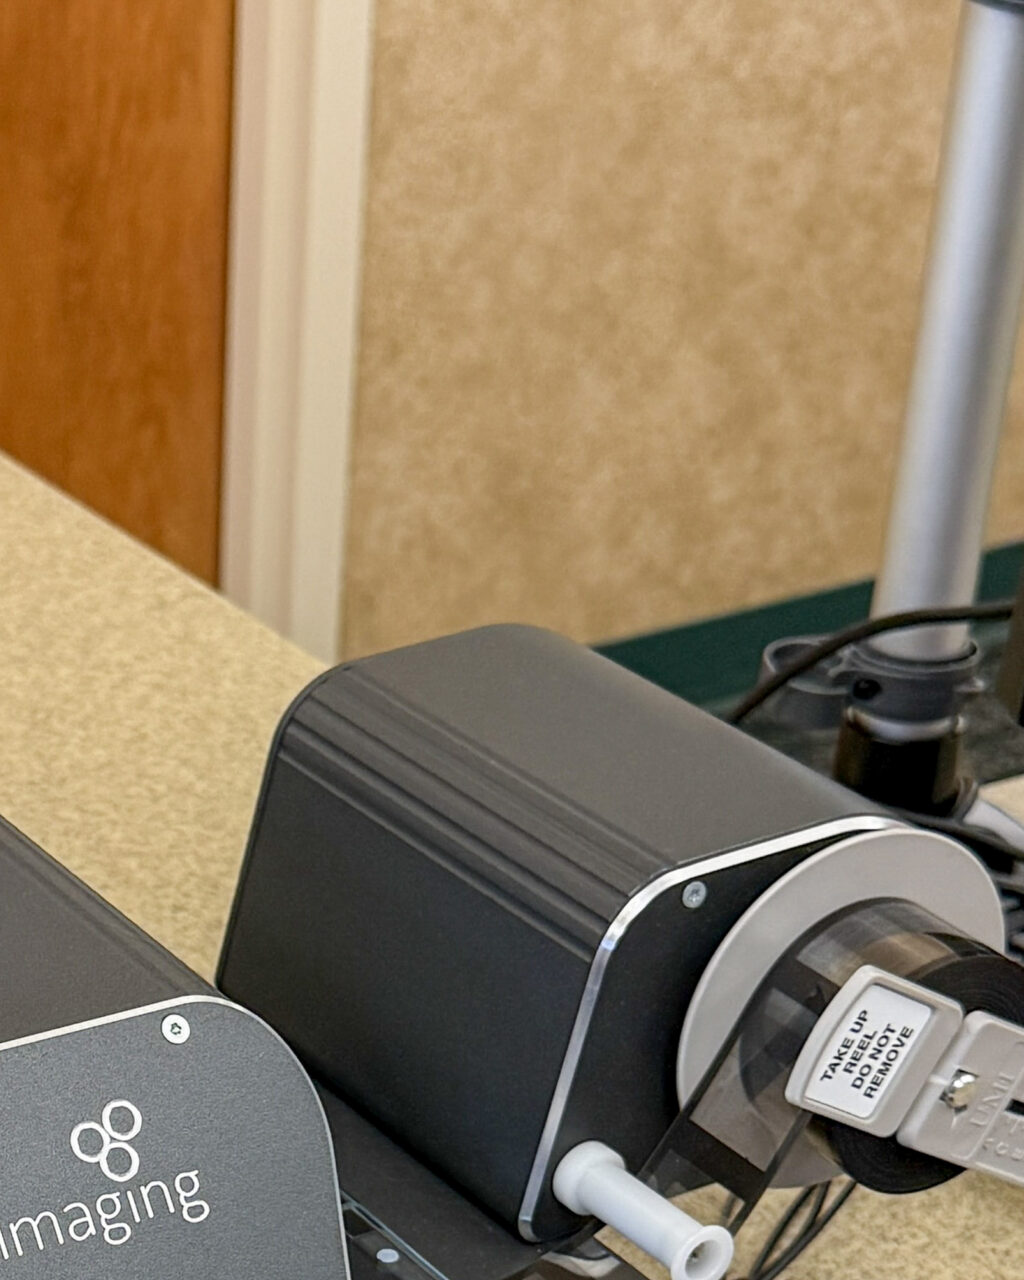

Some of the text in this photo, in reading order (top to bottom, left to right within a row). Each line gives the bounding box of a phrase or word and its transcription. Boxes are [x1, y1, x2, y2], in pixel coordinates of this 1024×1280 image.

[820, 1010, 868, 1082] TAKE UP
[843, 1030, 878, 1074] REEL
[851, 1023, 896, 1090] DO NOT
[863, 1026, 914, 1099] REMOVE
